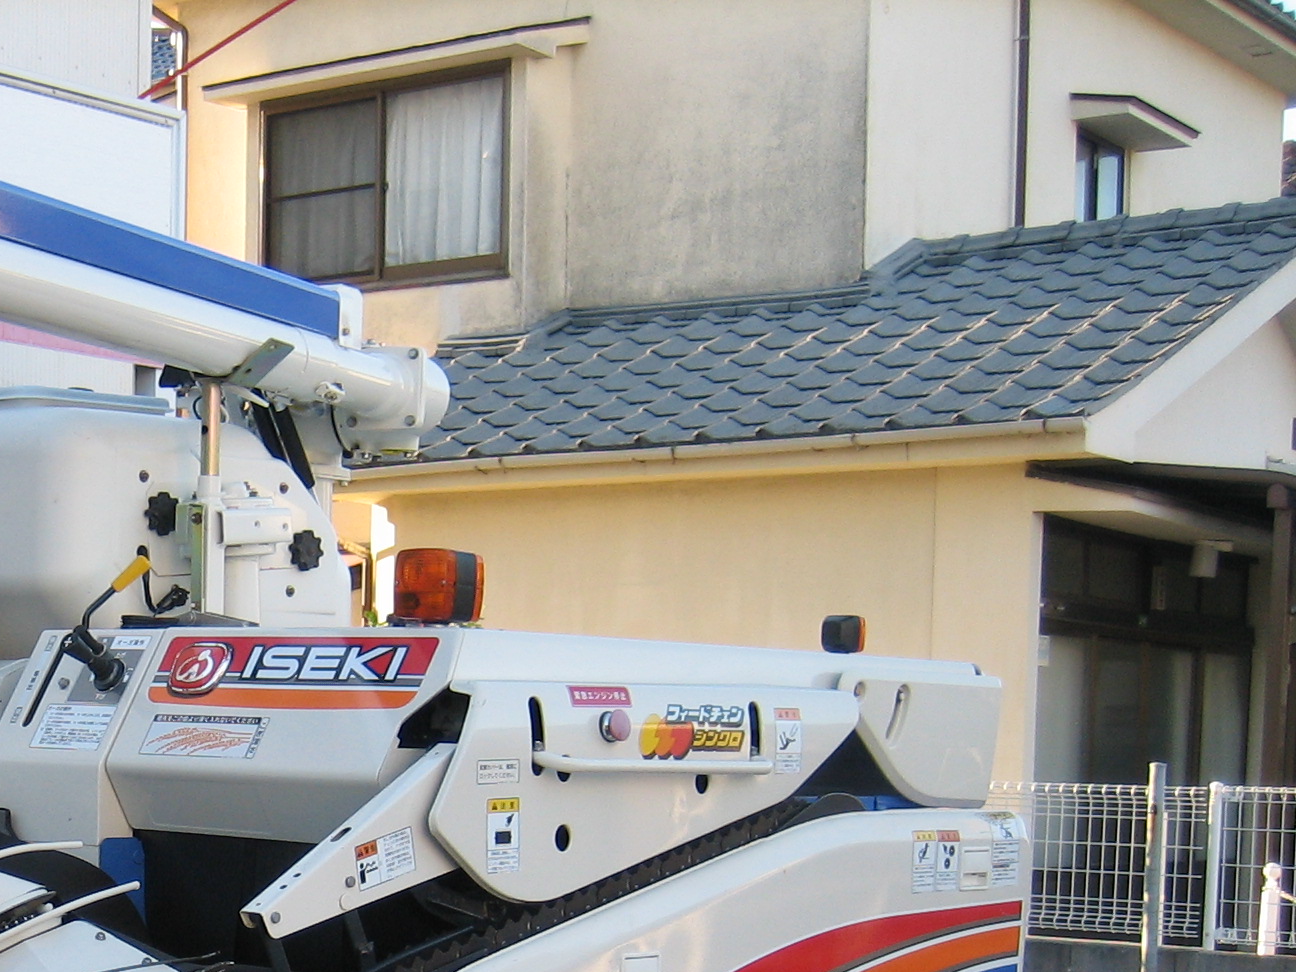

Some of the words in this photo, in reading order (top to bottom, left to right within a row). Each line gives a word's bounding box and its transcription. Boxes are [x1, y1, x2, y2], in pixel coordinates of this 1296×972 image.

[241, 646, 409, 681] ISEKI
[667, 705, 744, 726] フィードチェン
[693, 731, 744, 748] シンクロ
